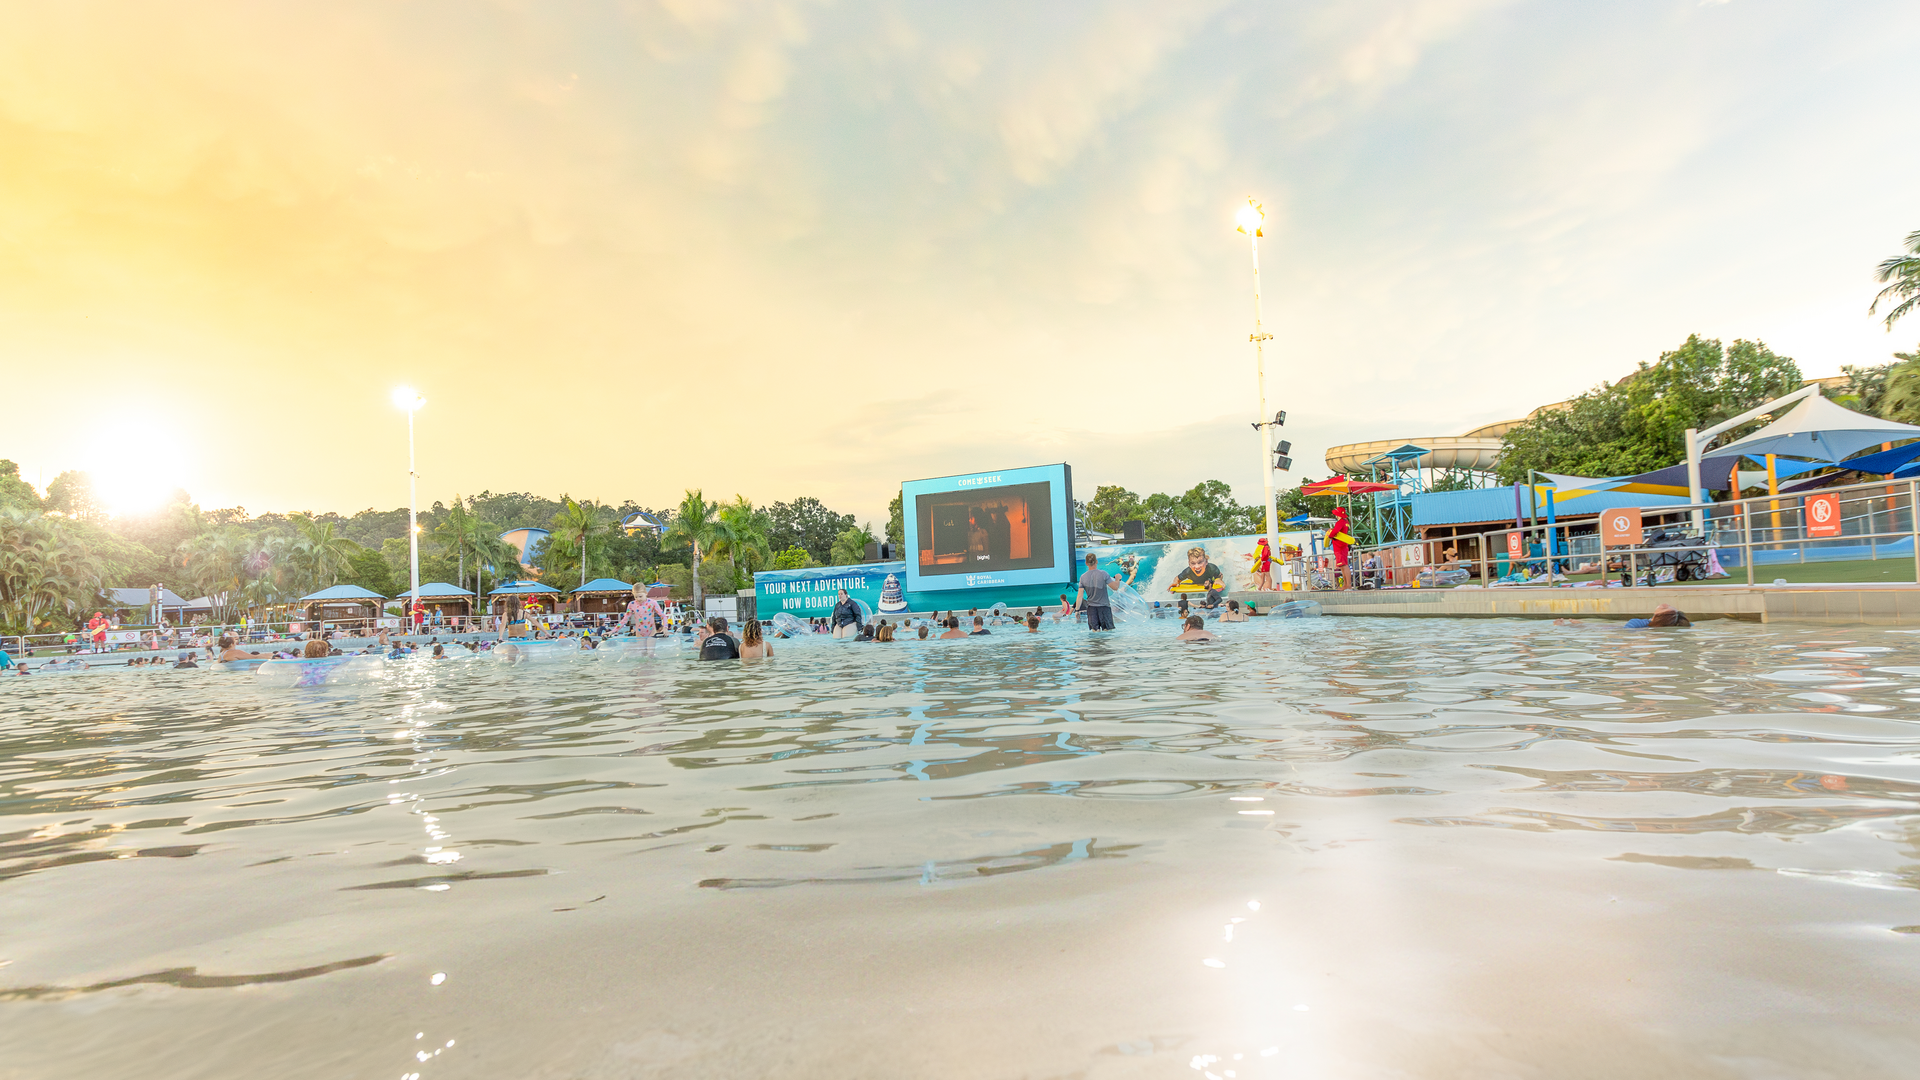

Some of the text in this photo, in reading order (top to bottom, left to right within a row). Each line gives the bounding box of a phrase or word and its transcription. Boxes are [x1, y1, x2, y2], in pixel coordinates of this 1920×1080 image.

[958, 475, 1002, 486] COME SEEK
[764, 577, 870, 594] YOUR NEXT ADVENTURE,
[782, 595, 850, 610] NOW BOARDI
